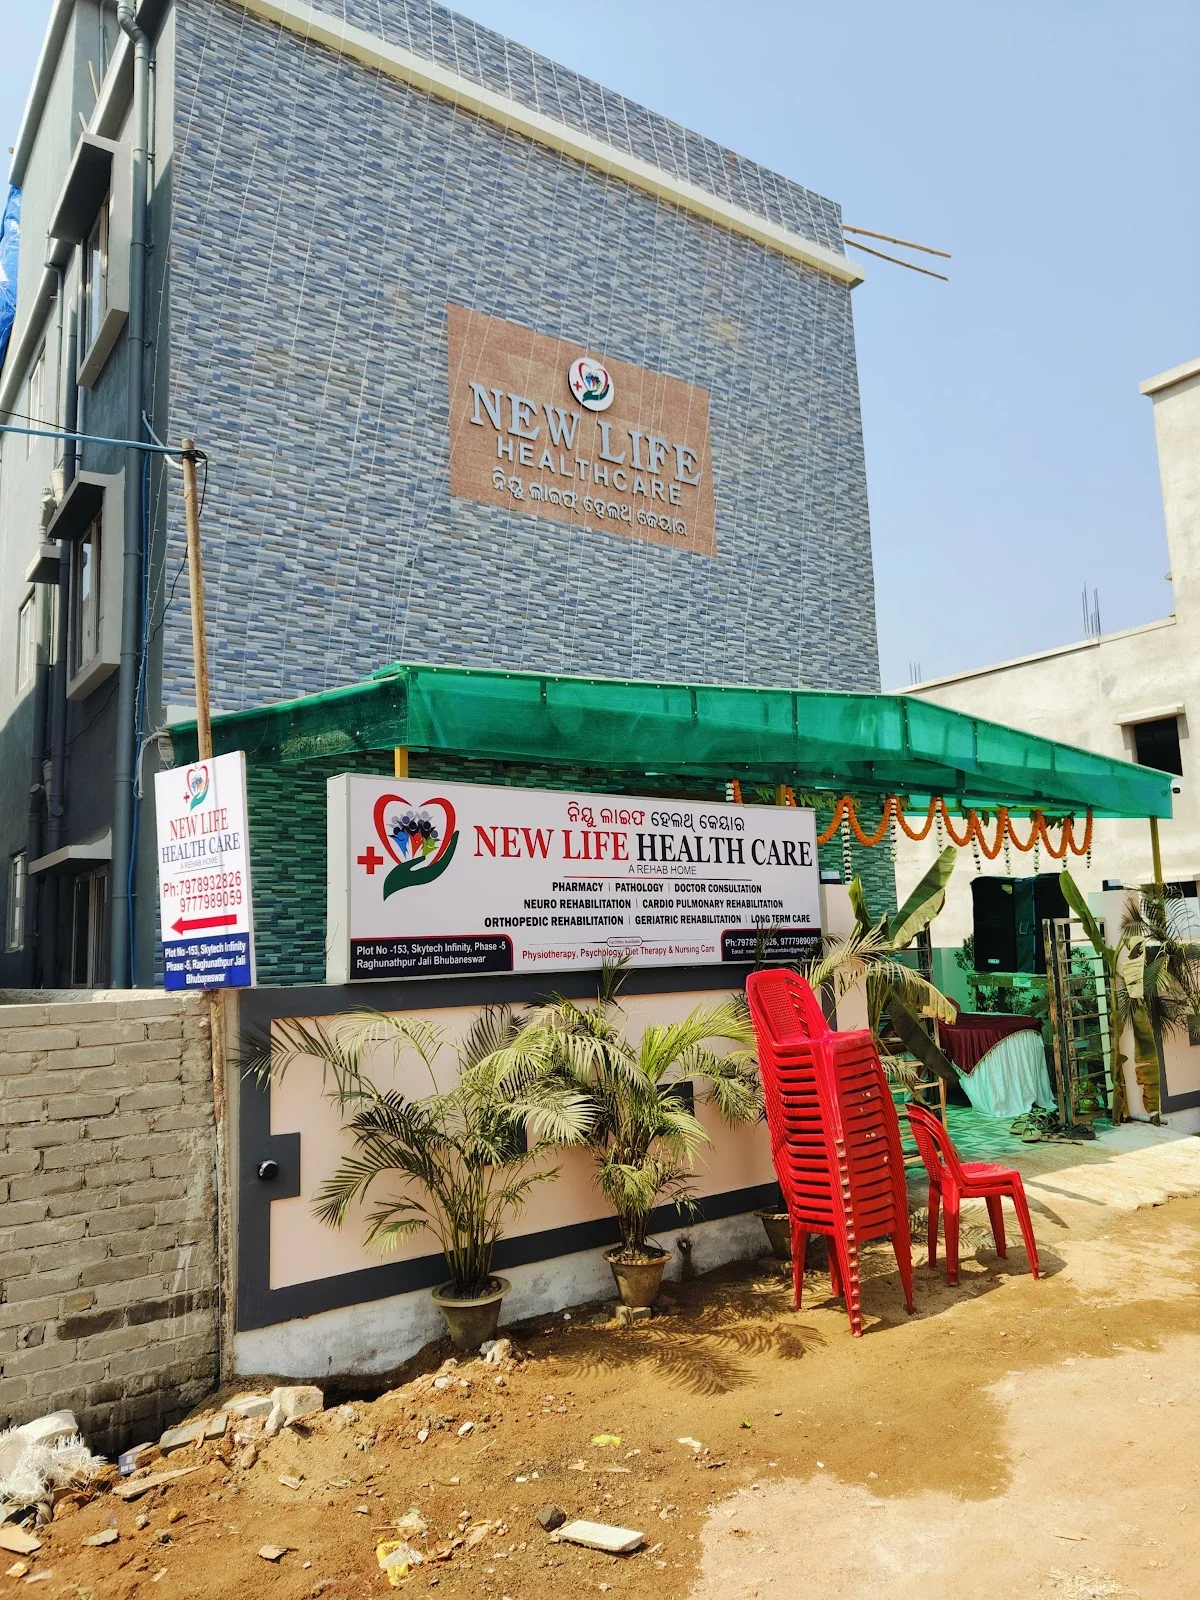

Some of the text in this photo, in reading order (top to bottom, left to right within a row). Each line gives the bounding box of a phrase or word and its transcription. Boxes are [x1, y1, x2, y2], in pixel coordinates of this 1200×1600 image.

[469, 381, 701, 486] NEW LIFE
[496, 436, 682, 506] HEALTHCARE
[169, 808, 229, 841] NEW LIFE
[161, 832, 241, 863] HEALTH CARE
[473, 825, 813, 867] NEW LIFE HEALTH CARE
[184, 859, 202, 869] REHAB
[203, 856, 218, 866] HOME
[628, 864, 697, 875] A REHAB HOME
[163, 871, 242, 898] Ph:7978932826
[552, 882, 762, 893] PHARMACY PATHOLOGY DOCTOR CONSULTATION
[180, 889, 242, 913] 9777989059
[524, 899, 783, 909] NEURO REHABILITATION CARDIO PULMONARY REHABILITATION
[484, 915, 811, 927] ORTHOPEDIC REHABILITATION GERIATRIC REHABILITATION LONG TERM CARE
[164, 941, 246, 958] Plot No -153, Skytech Infinity
[356, 941, 506, 956] Plot No -153, Skytech Infinity, Phase -5
[725, 937, 780, 947] Ph:7978926,
[522, 944, 715, 961] Physiotherapy, Psychology, Diet Therapy & Nursing Care
[166, 961, 184, 972] Phase
[192, 957, 234, 971] Raghunathpur
[234, 955, 246, 966] Jali
[356, 955, 486, 970] Raghunathpur Jali Bhubaneswar
[185, 973, 226, 985] Bhubaneswar
